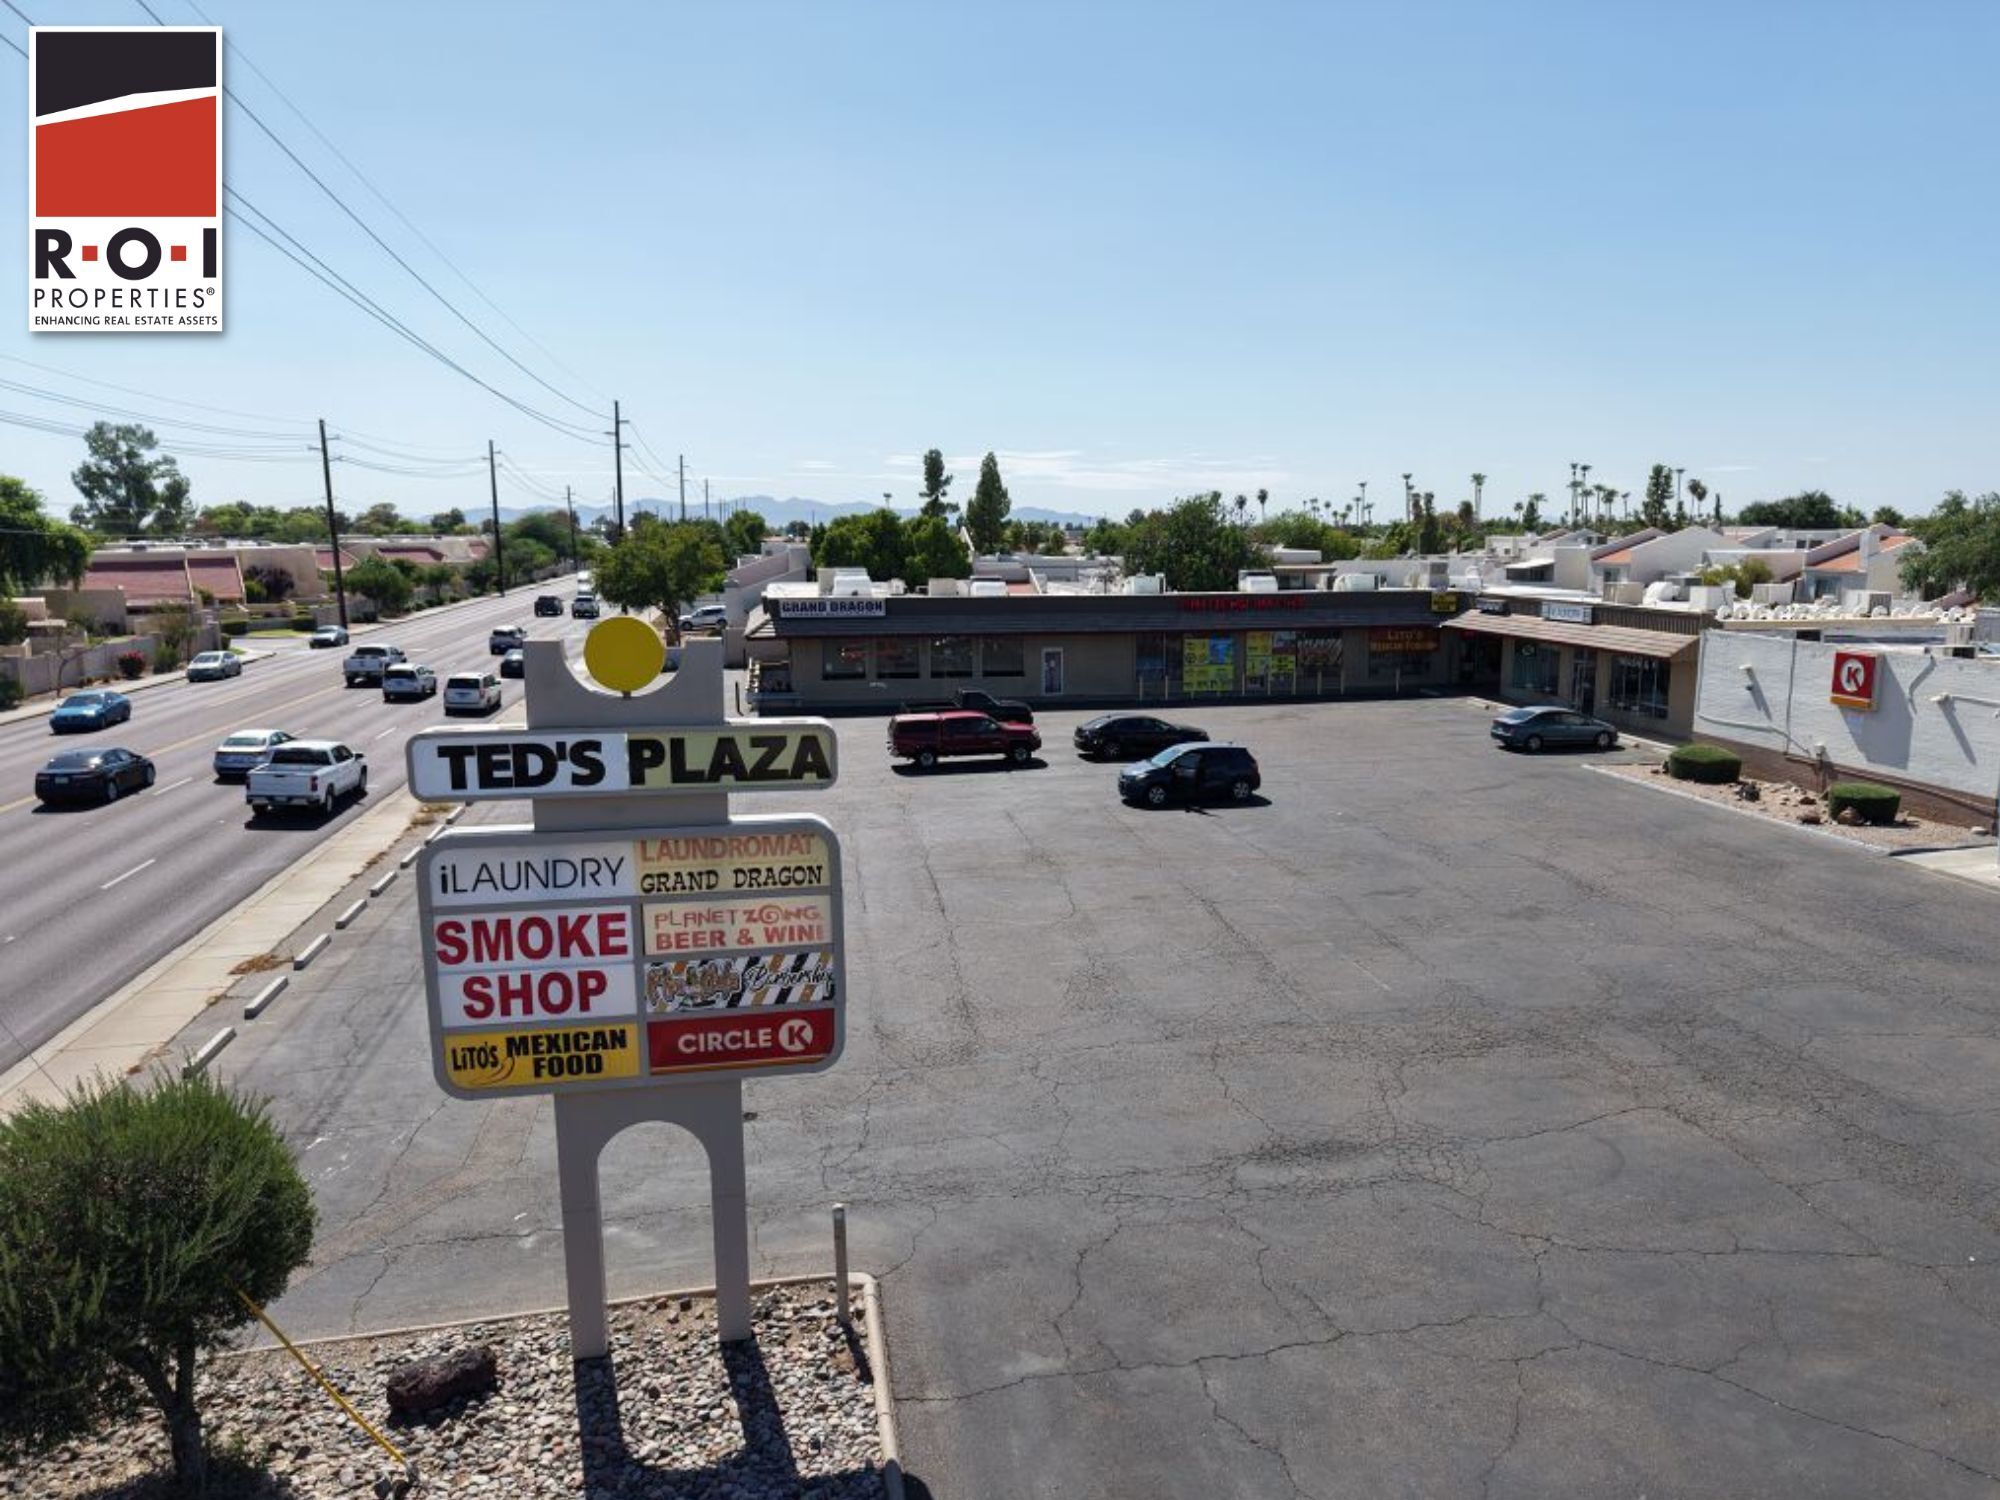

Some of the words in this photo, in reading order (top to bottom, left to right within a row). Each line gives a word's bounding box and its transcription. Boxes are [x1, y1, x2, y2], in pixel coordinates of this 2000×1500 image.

[830, 600, 883, 612] DRAGON
[437, 740, 606, 790] TED'S
[629, 735, 832, 786] PLAZA
[641, 834, 816, 863] LAUNDROMAT
[440, 856, 625, 895] iLAUNDRY
[640, 869, 719, 894] GRAND
[733, 865, 823, 889] DRAGON
[655, 908, 740, 930] PLANET
[436, 912, 629, 966] SMOKE
[656, 930, 726, 951] BEER
[737, 928, 754, 946] &
[462, 970, 609, 1020] SHOP
[505, 1028, 627, 1058] MEXICAN
[678, 1027, 772, 1054] CIRCLE
[533, 1053, 603, 1079] FOOD
